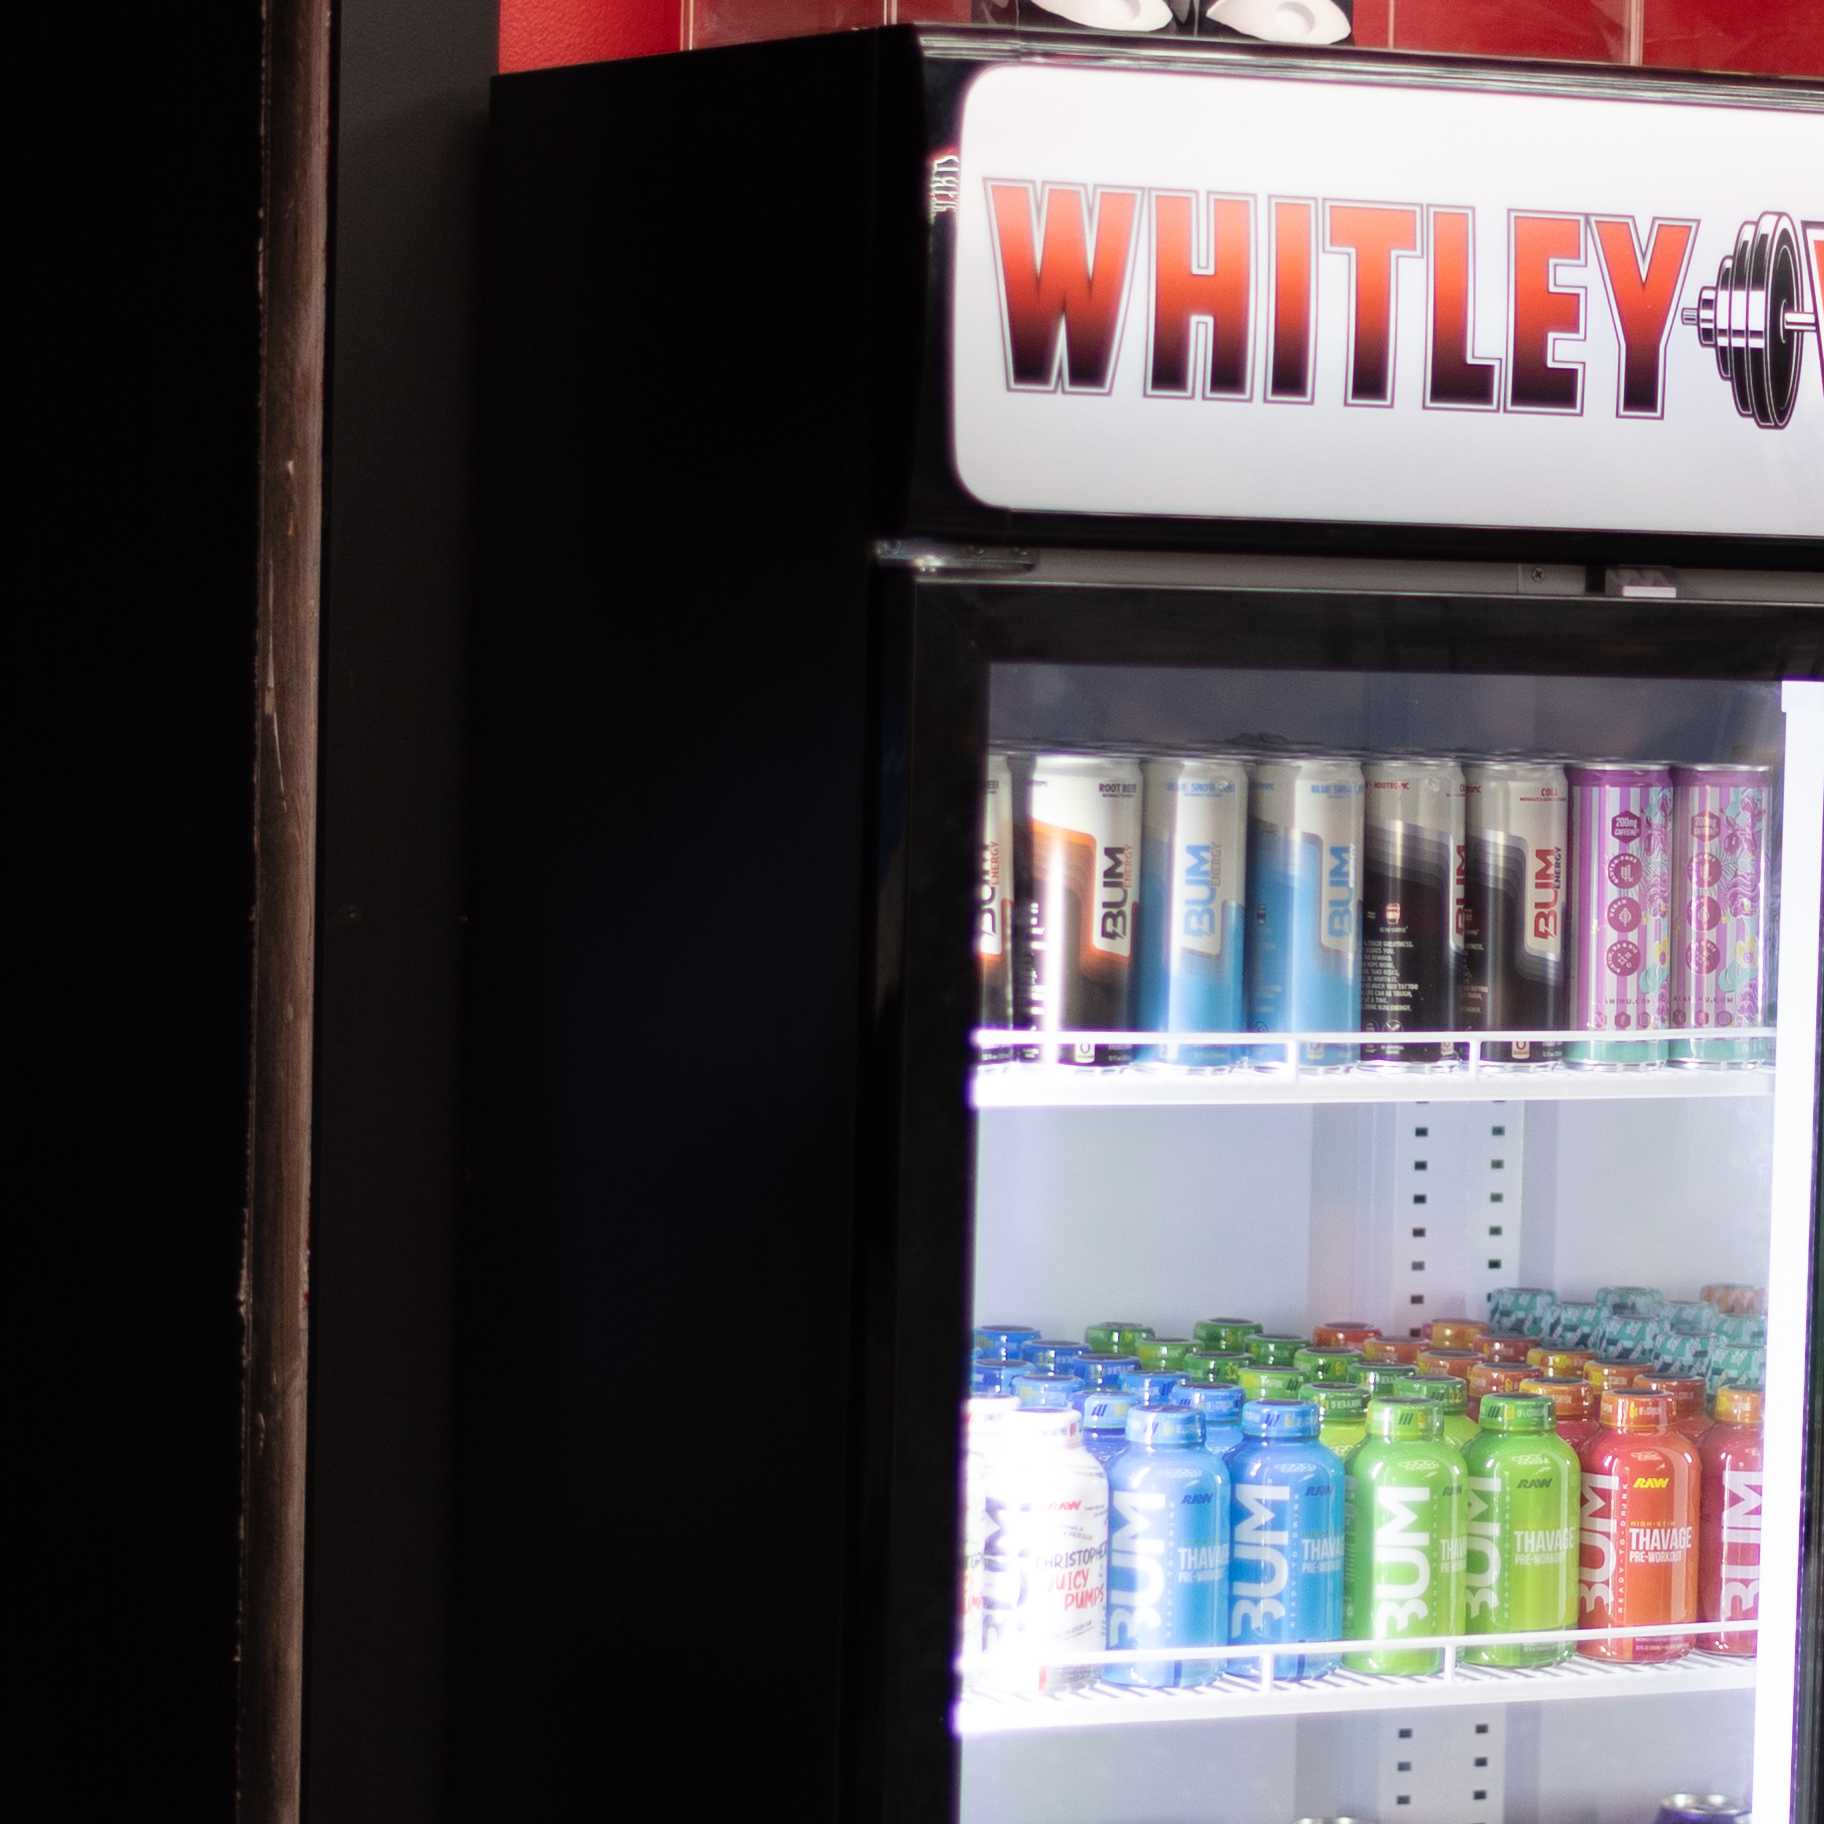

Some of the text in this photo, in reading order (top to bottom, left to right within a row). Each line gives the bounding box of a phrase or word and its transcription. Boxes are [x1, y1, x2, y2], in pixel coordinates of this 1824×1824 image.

[982, 177, 1700, 420] WHITLEY
[1101, 845, 1127, 940] BUM
[1184, 844, 1213, 940] BUM
[1328, 845, 1353, 939] BUM
[1535, 848, 1558, 940] BUM
[1517, 1478, 1553, 1489] RAW
[1633, 1478, 1670, 1489] RAW
[1181, 1493, 1213, 1505] RAW
[1514, 1527, 1574, 1554] THAVAGE
[1629, 1526, 1692, 1553] THAVAGE
[1629, 1549, 1682, 1564] PRE-WORKOUT
